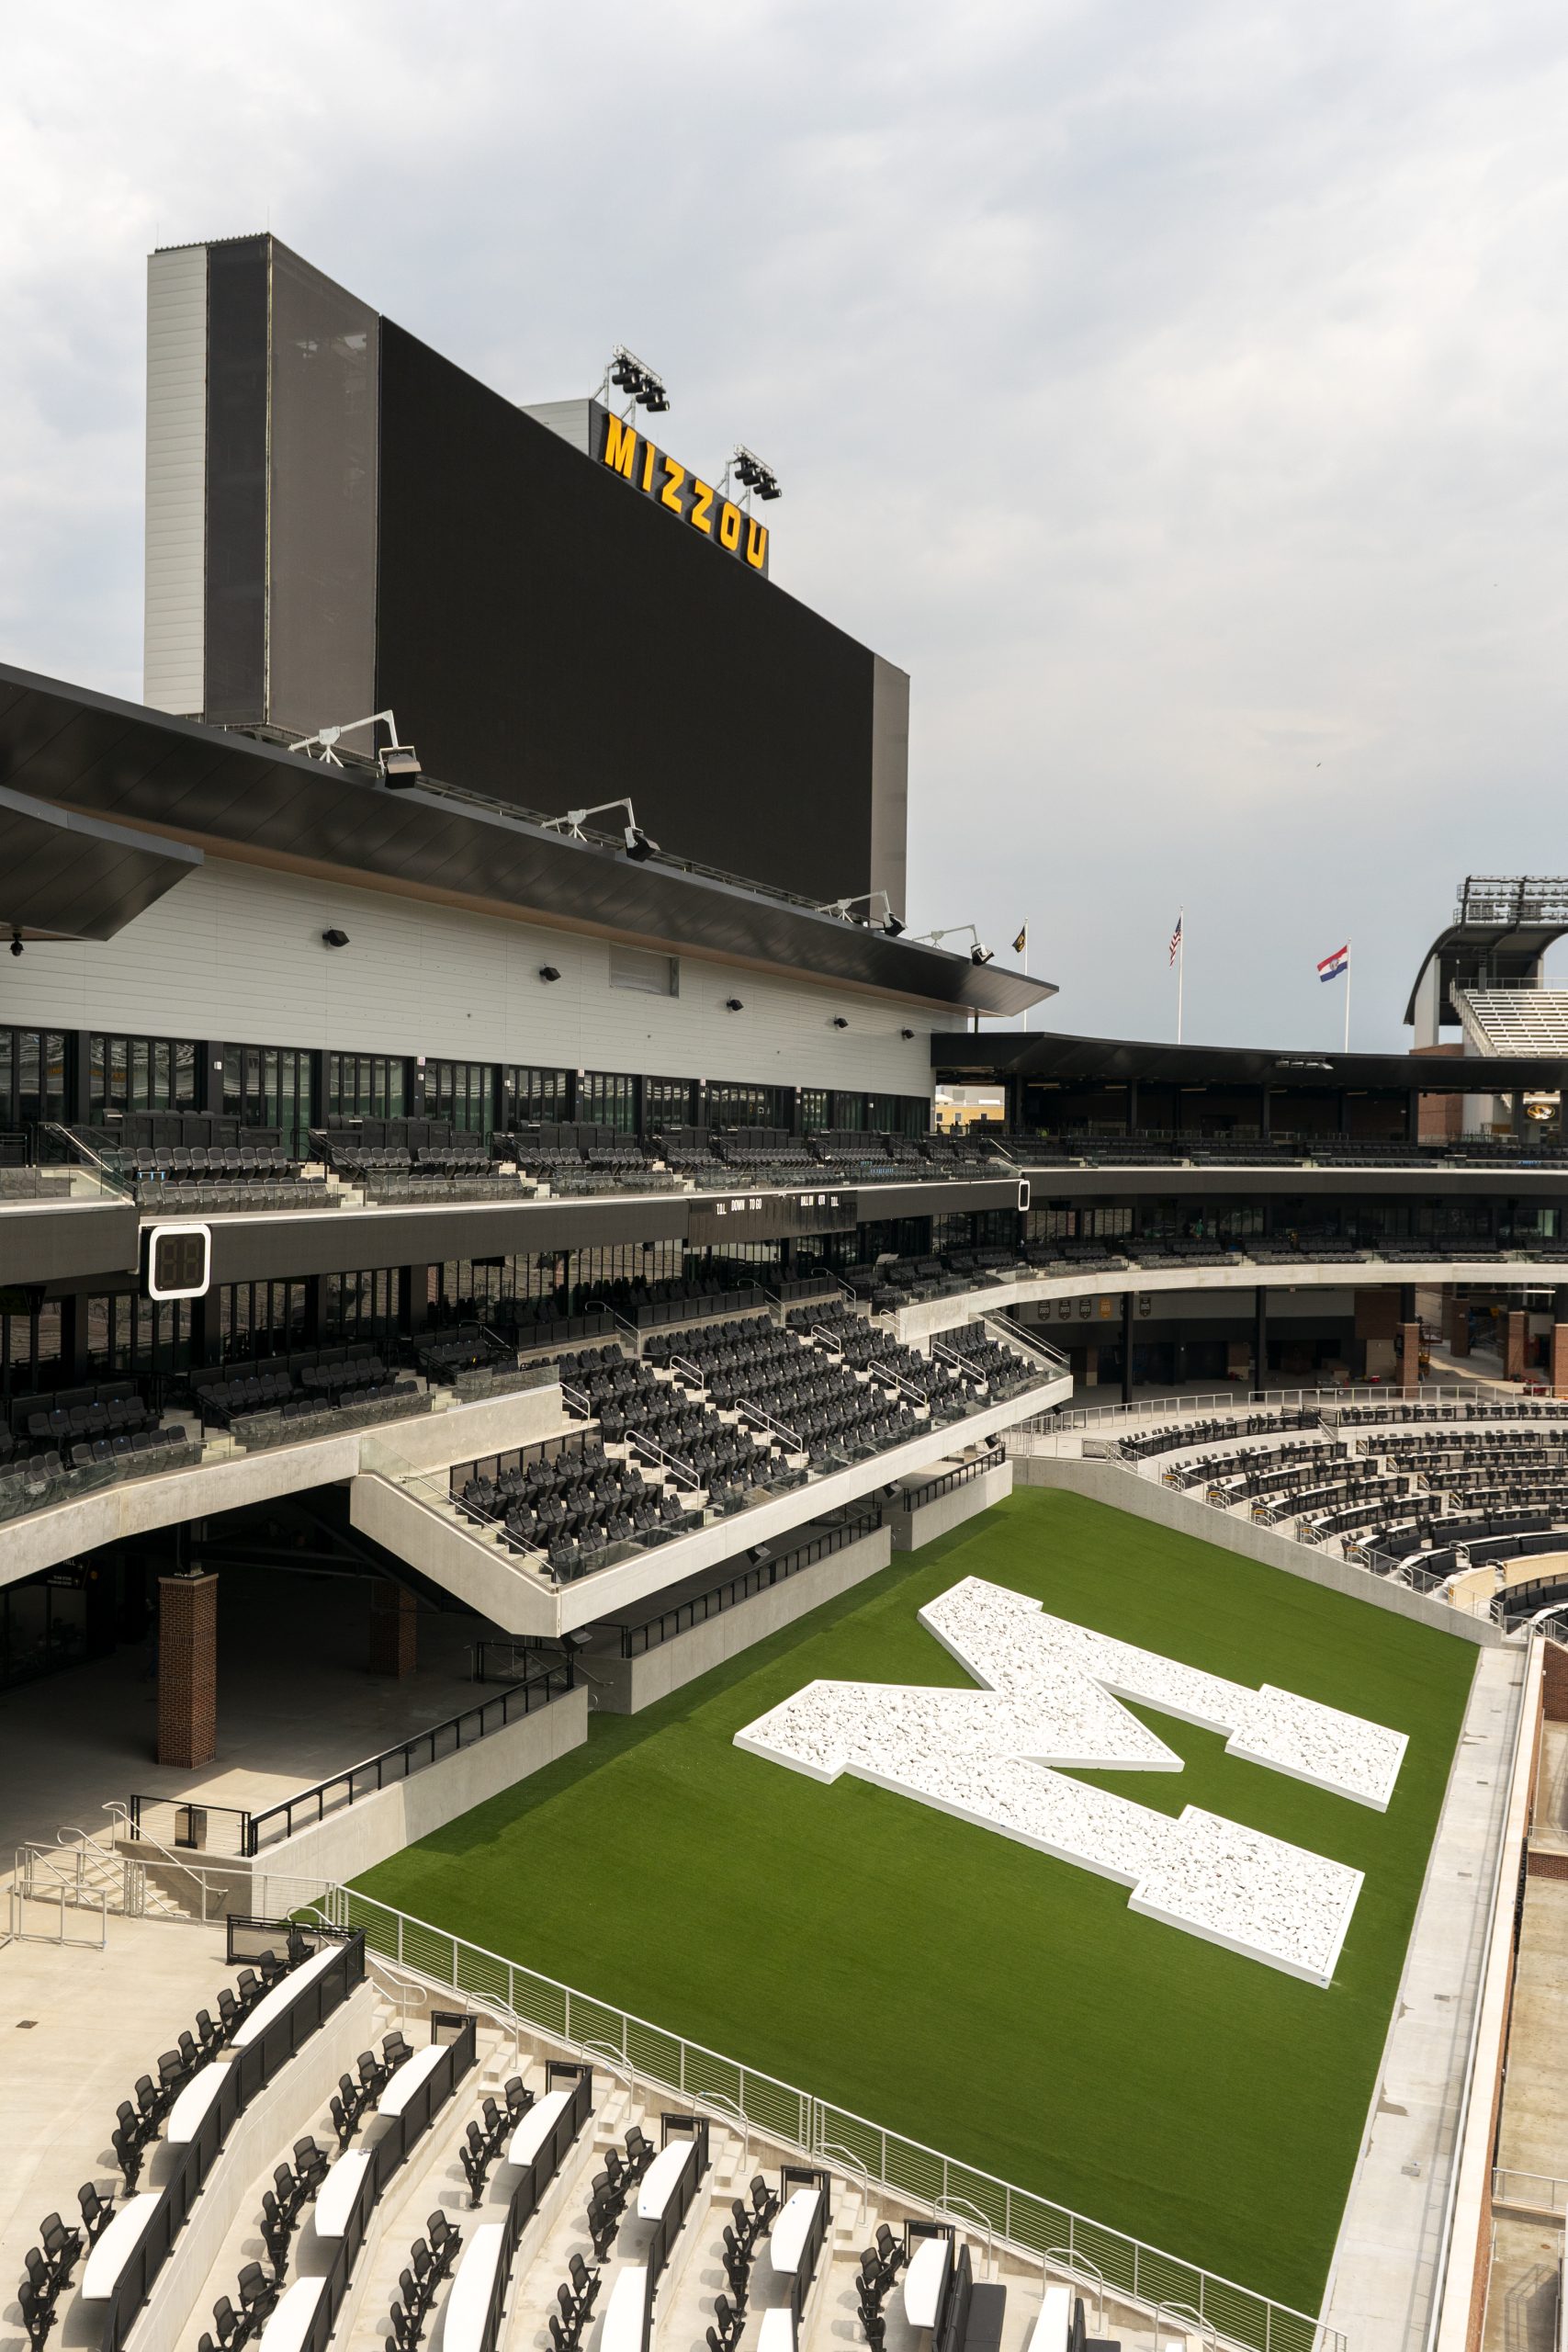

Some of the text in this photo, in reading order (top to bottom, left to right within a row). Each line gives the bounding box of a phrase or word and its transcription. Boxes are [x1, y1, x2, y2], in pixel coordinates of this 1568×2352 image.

[604, 413, 767, 570] MIZZOU
[731, 1199, 745, 1211] DOWN
[750, 1197, 762, 1210] TO GO
[733, 1575, 1410, 1989] M
